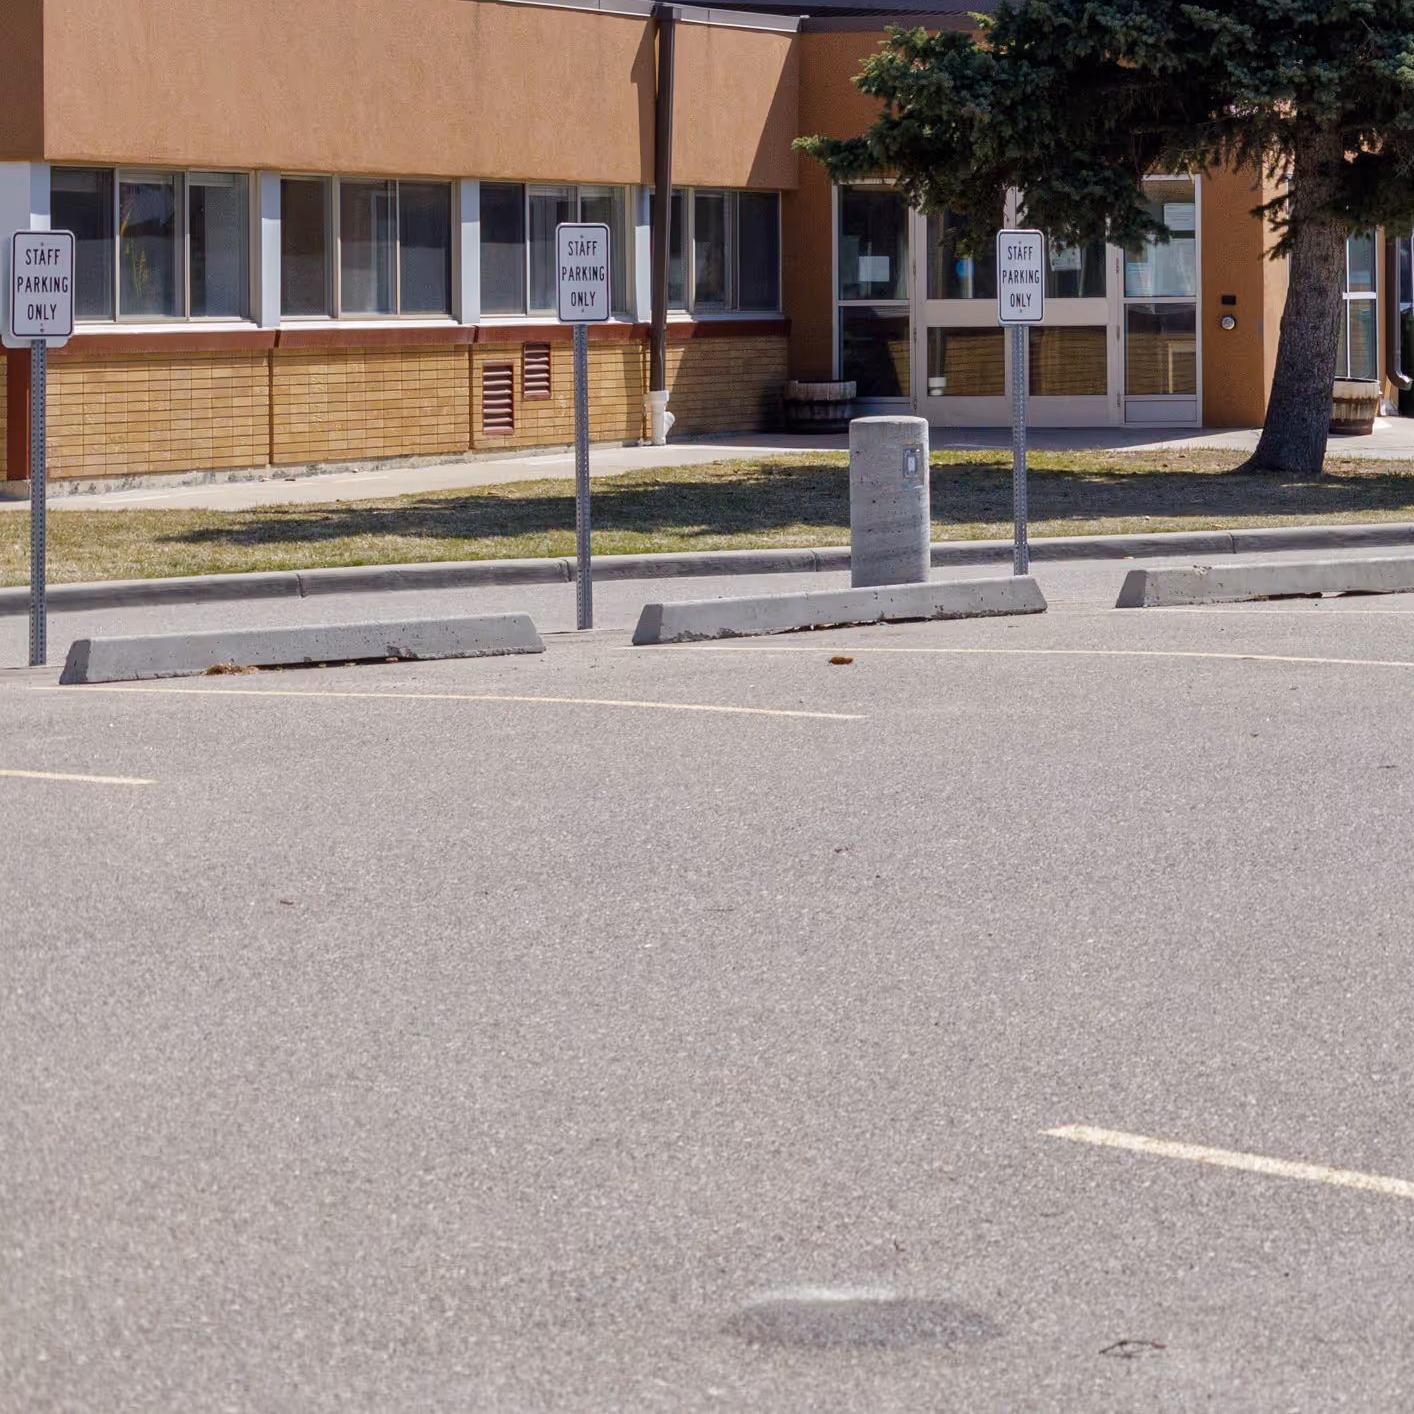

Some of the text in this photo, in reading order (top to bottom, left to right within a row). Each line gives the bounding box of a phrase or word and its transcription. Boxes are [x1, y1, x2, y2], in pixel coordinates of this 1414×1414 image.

[568, 240, 598, 256] STAFF
[1007, 246, 1033, 260] STAFF
[25, 248, 61, 266] STAFF
[561, 266, 605, 282] PARKING
[1002, 269, 1040, 284] PARKING
[17, 276, 69, 293] PARKING
[570, 291, 596, 307] ONLY
[1010, 293, 1032, 307] ONLY
[27, 303, 57, 320] ONLY
